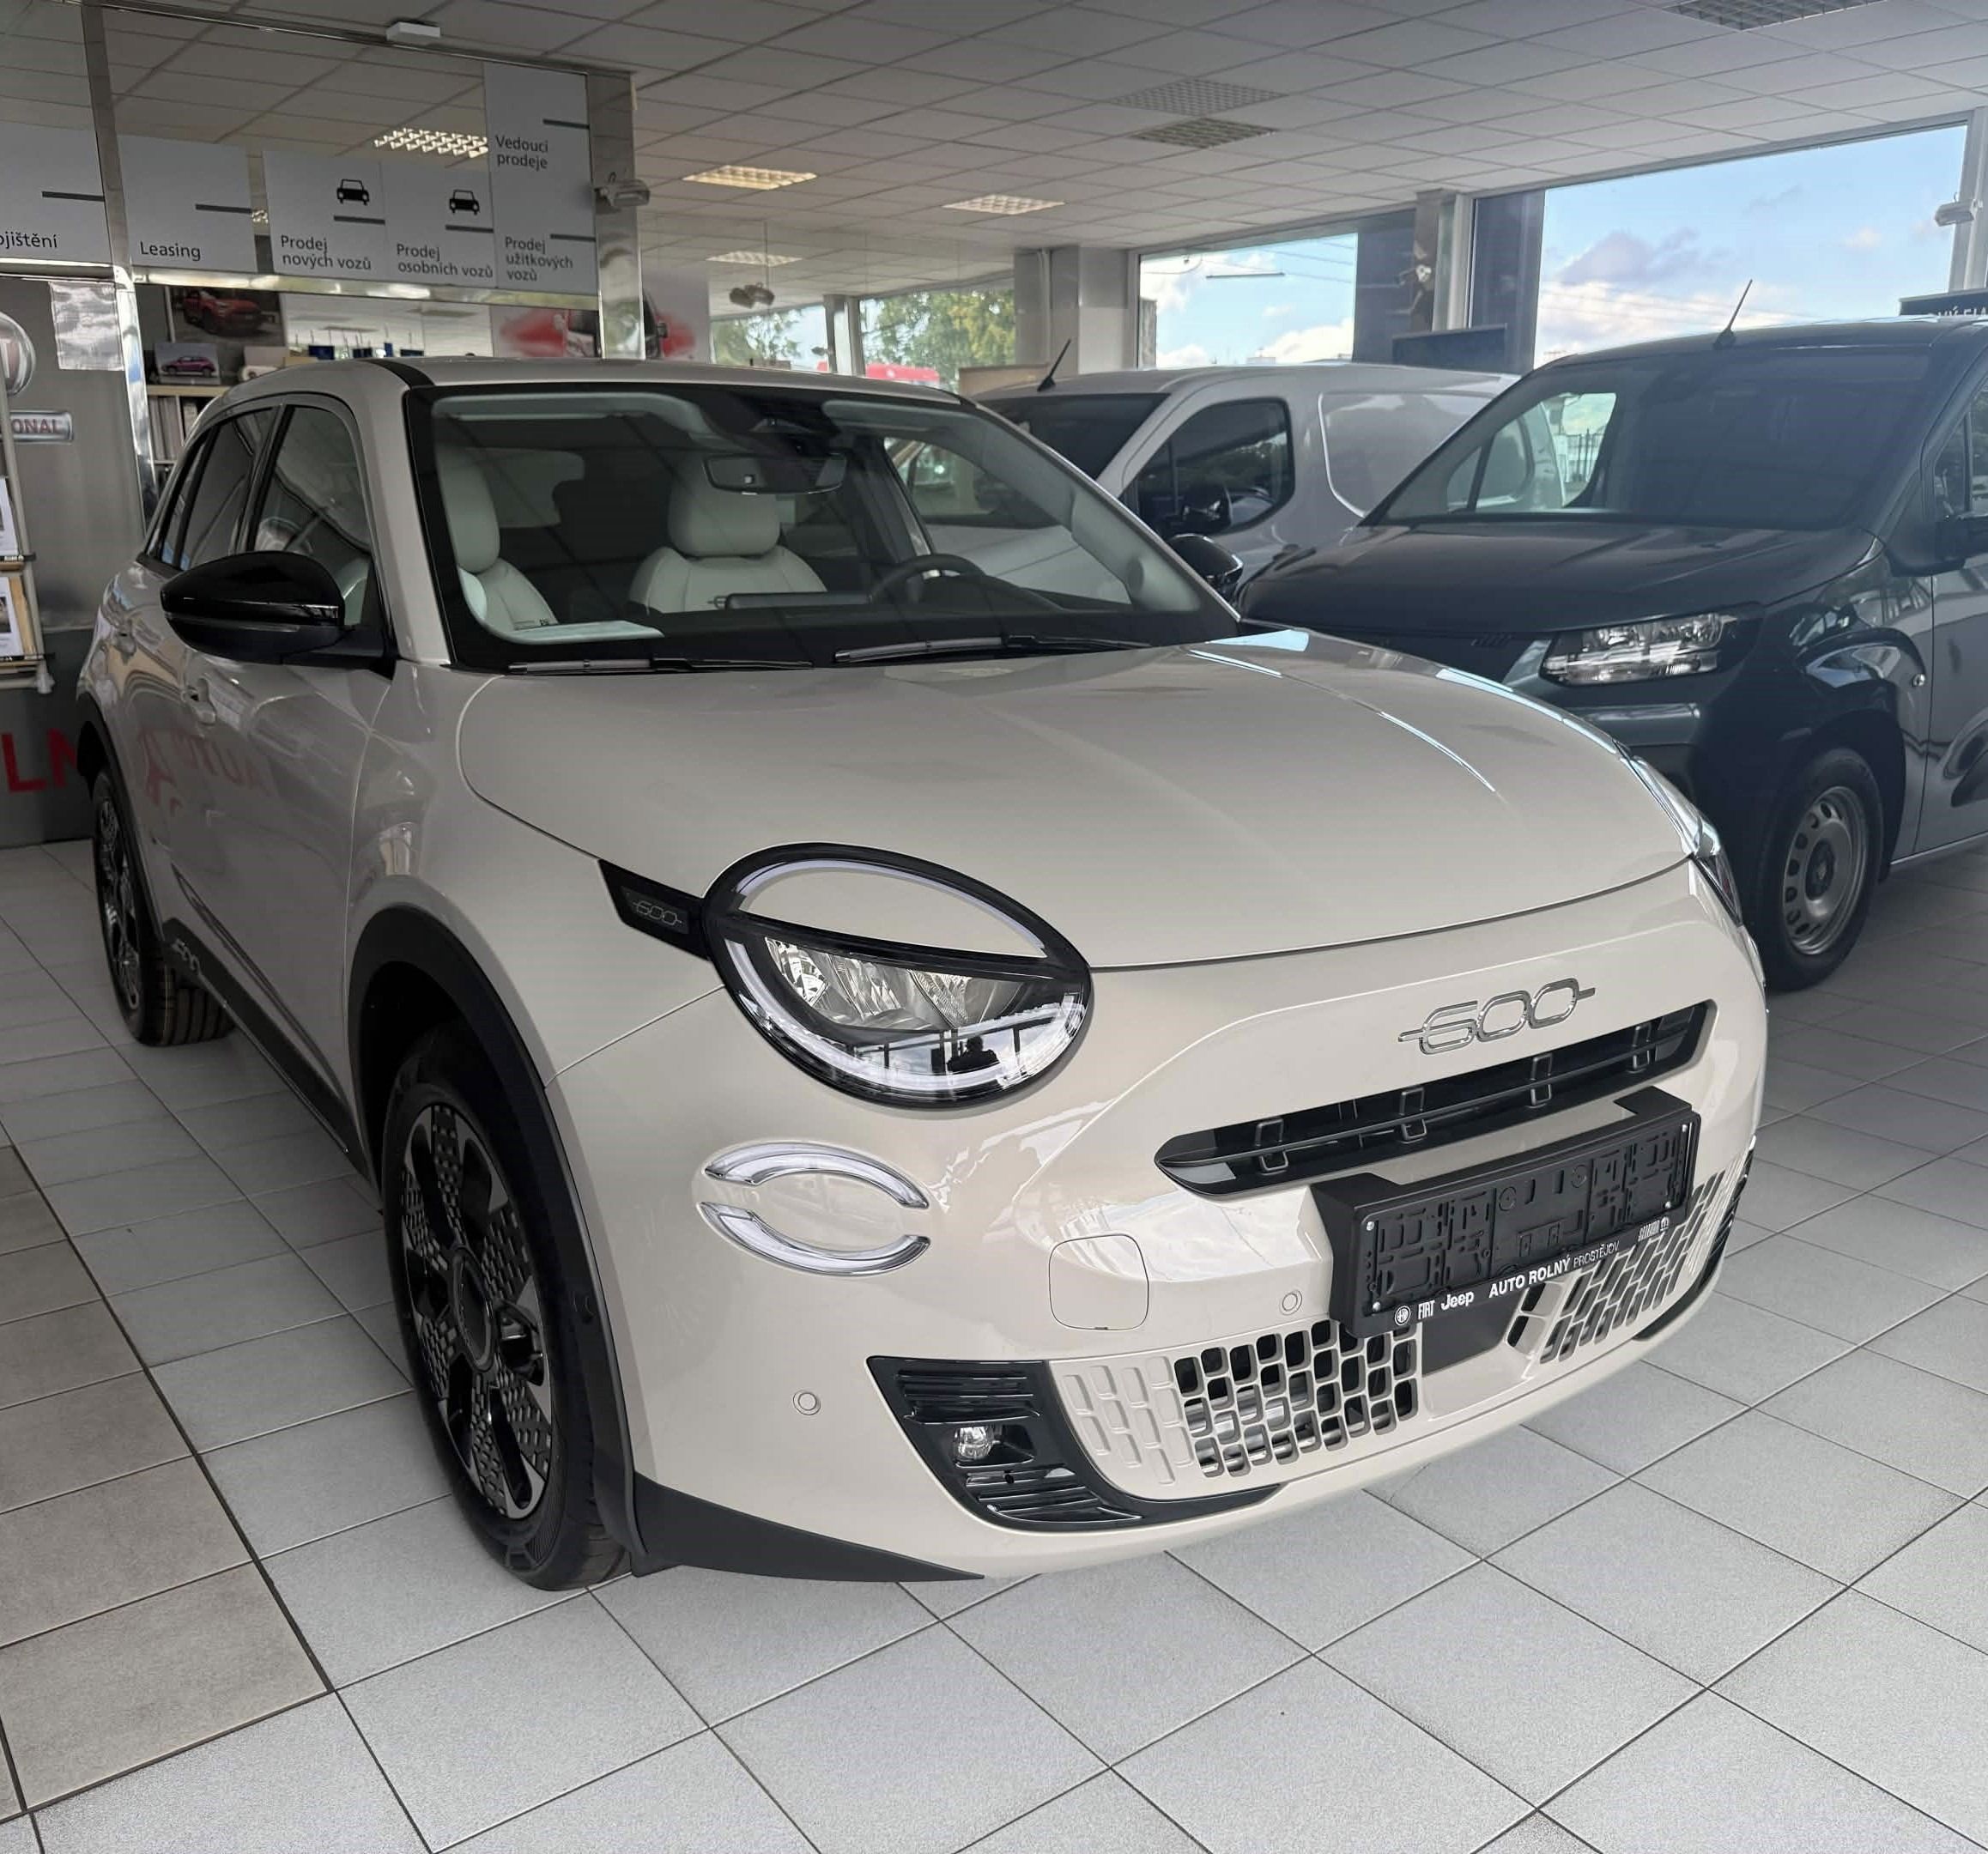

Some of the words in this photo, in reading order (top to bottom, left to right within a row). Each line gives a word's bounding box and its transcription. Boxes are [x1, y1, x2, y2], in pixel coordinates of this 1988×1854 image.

[497, 154, 548, 172] prodeje
[140, 241, 201, 261] Leasing
[281, 234, 328, 254] Prodej
[397, 243, 440, 262] Prodej
[505, 236, 546, 255] Prodej
[282, 253, 333, 270] nových
[337, 257, 372, 270] vozů
[397, 261, 458, 276] osobních
[462, 264, 494, 278] vozů
[506, 252, 573, 270] užitkových
[506, 268, 537, 282] vozů
[633, 900, 682, 926] 600
[1398, 978, 1596, 1055] 600
[1417, 1300, 1436, 1320] FIAT
[1440, 1291, 1475, 1311] Jeep
[1488, 1275, 1525, 1299] AUTO
[1528, 1254, 1572, 1286] ROLNÝ
[1573, 1240, 1620, 1269] PROSTĚJOV
